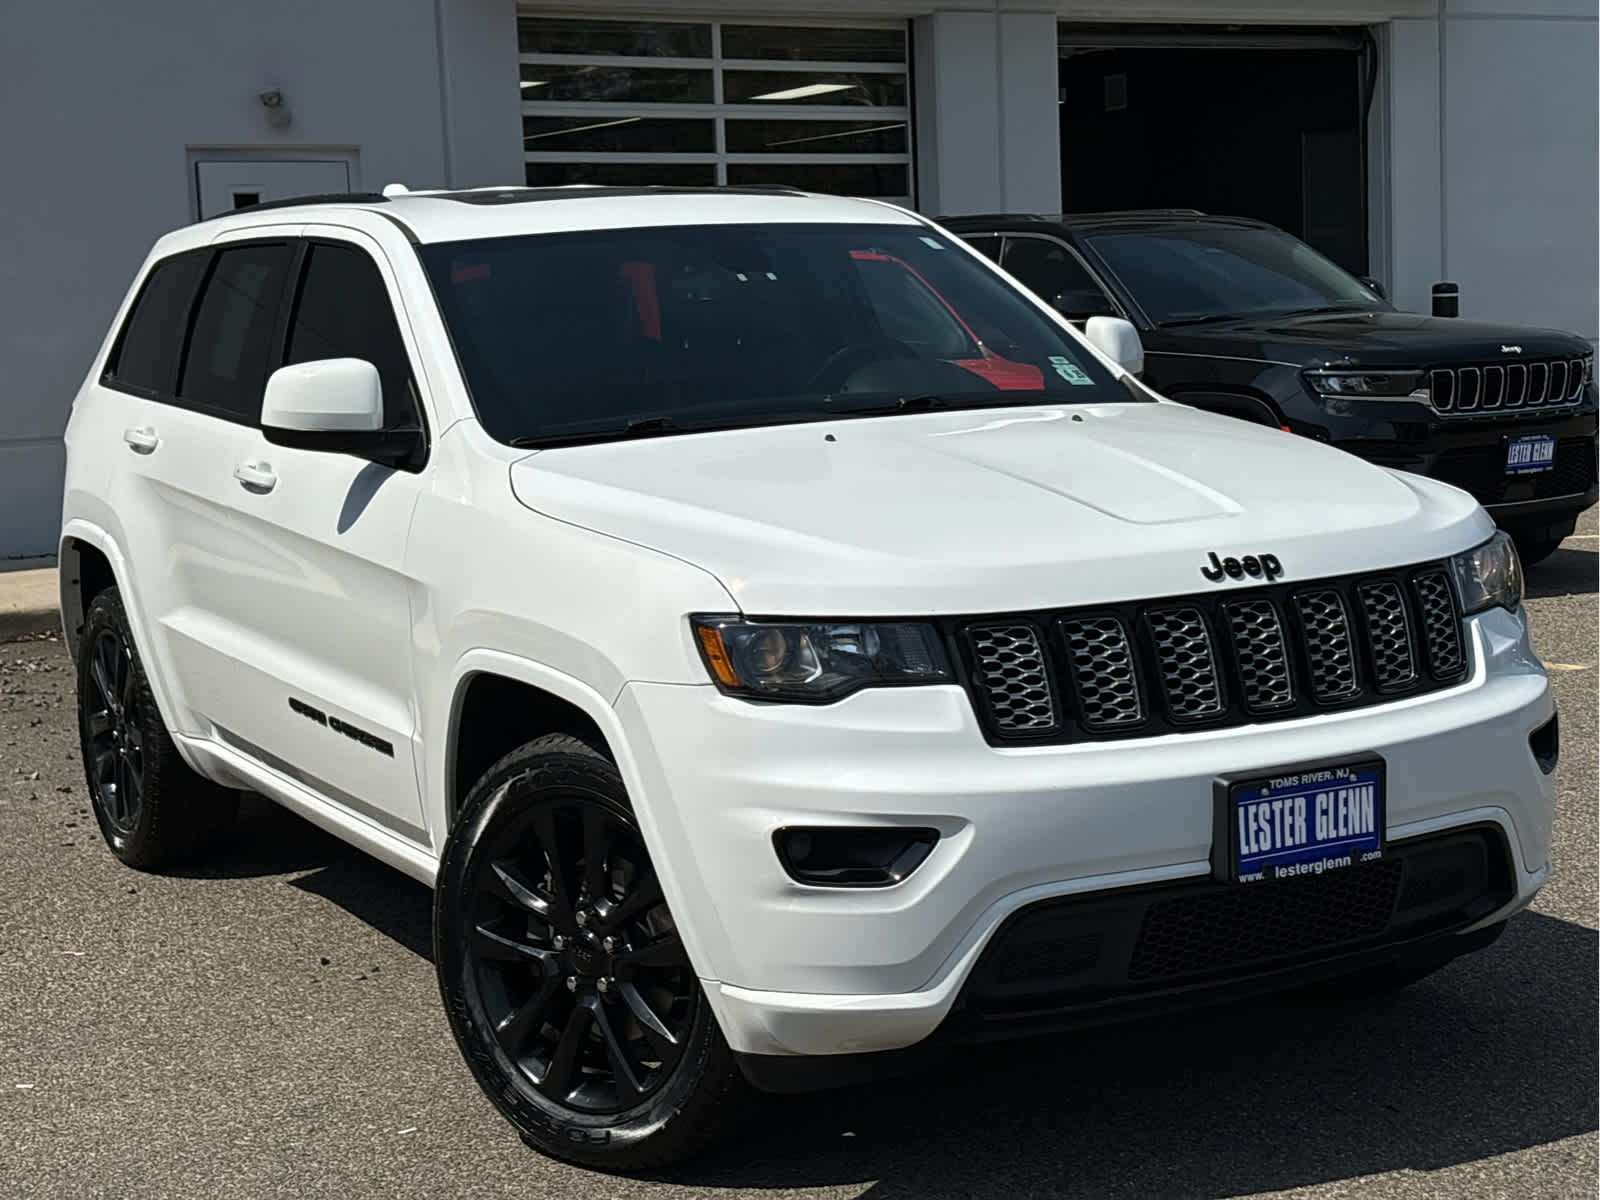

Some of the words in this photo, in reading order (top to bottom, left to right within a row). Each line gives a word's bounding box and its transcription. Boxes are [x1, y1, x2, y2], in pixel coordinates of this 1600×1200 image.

[1200, 552, 1284, 584] Jeep
[1270, 776, 1299, 790] TOMS
[1336, 768, 1350, 779] NJ
[1238, 797, 1307, 855] LESTER
[1315, 785, 1375, 841] GLENN
[1239, 871, 1265, 883] www.
[1275, 856, 1351, 879] lesterglenn
[1360, 850, 1382, 862] .com
